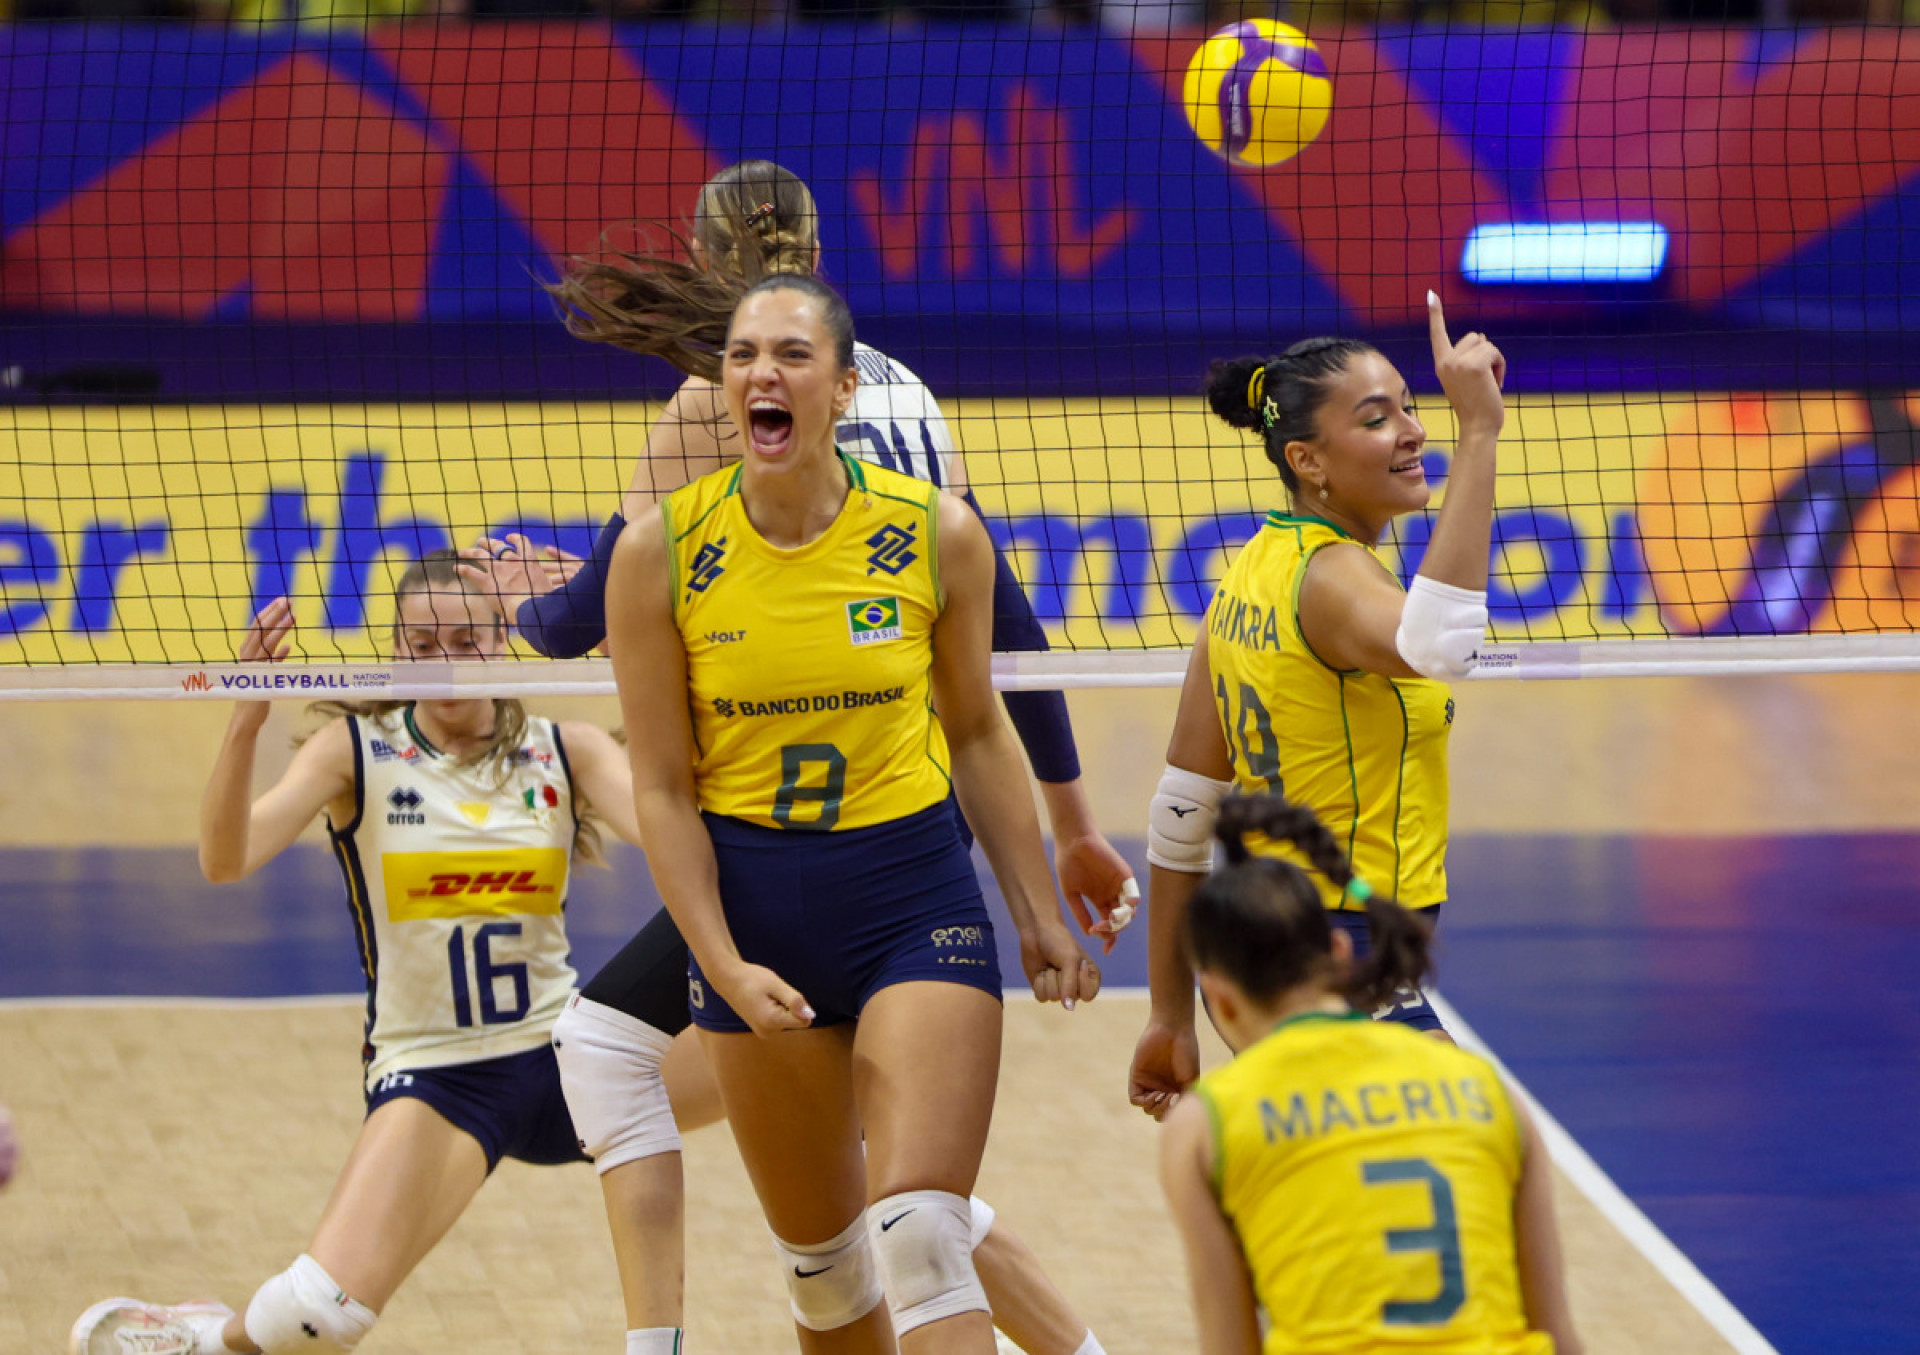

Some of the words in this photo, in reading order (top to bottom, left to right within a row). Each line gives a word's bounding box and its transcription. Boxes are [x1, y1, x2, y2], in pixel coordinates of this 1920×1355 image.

[852, 84, 1138, 279] VNL
[704, 630, 747, 643] VOLT
[852, 627, 899, 643] BRASIL
[181, 671, 214, 691] VNL
[220, 674, 349, 689] VOLLEYBALL
[353, 673, 391, 681] NATIONS
[738, 697, 809, 716] BANCO
[812, 694, 840, 711] DO
[842, 686, 905, 709] BRASIL
[770, 743, 848, 832] 8
[429, 871, 537, 897] DHL
[448, 922, 531, 1028] 16
[1258, 1077, 1495, 1146] MACRIS
[1360, 1157, 1468, 1328] 3
